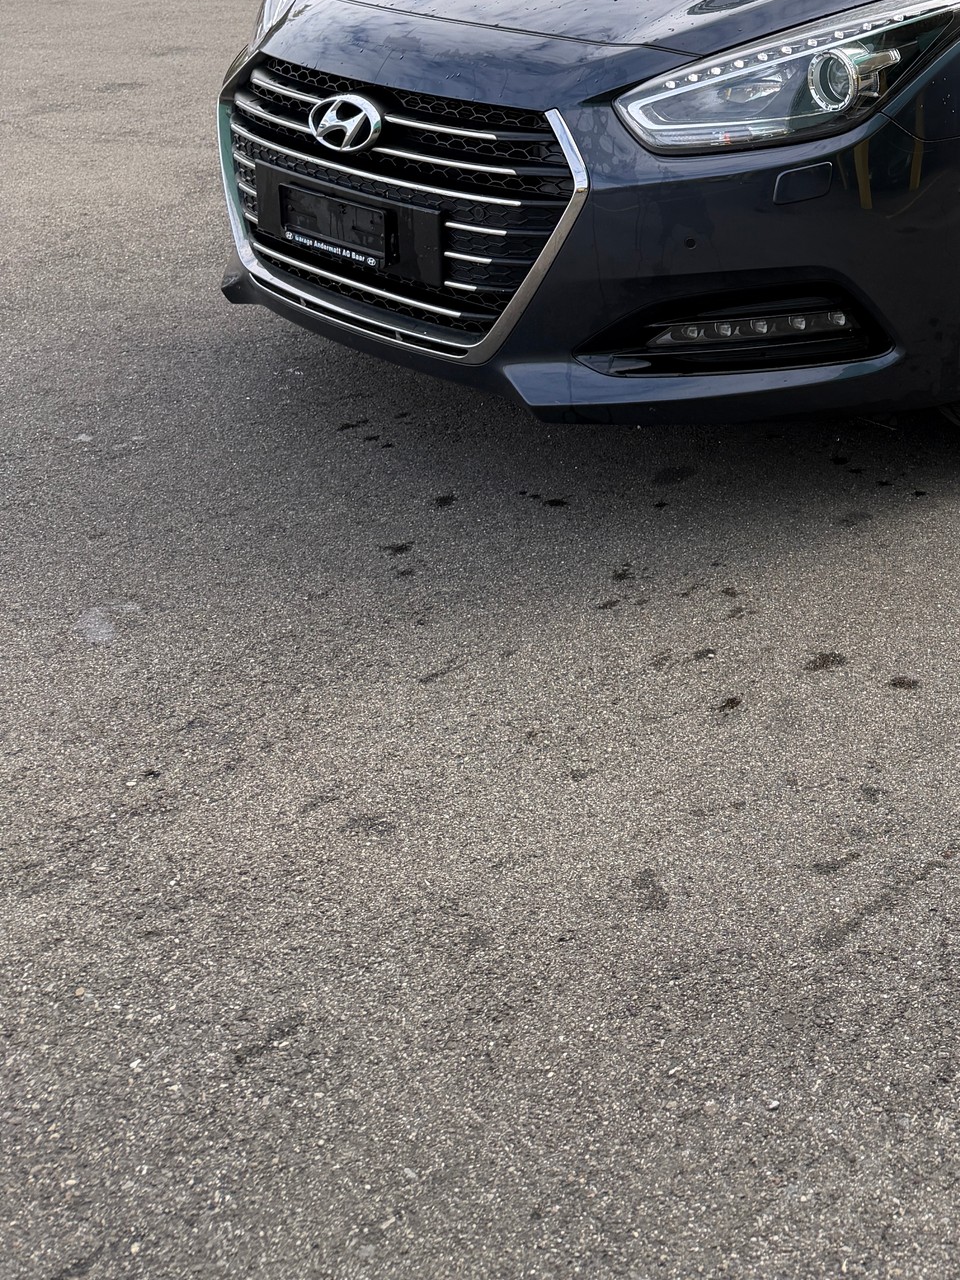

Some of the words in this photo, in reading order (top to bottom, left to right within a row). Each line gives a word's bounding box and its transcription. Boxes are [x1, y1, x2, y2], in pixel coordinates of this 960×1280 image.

[294, 234, 313, 246] Garage
[313, 240, 341, 255] Andermatt
[351, 252, 365, 262] Baar
